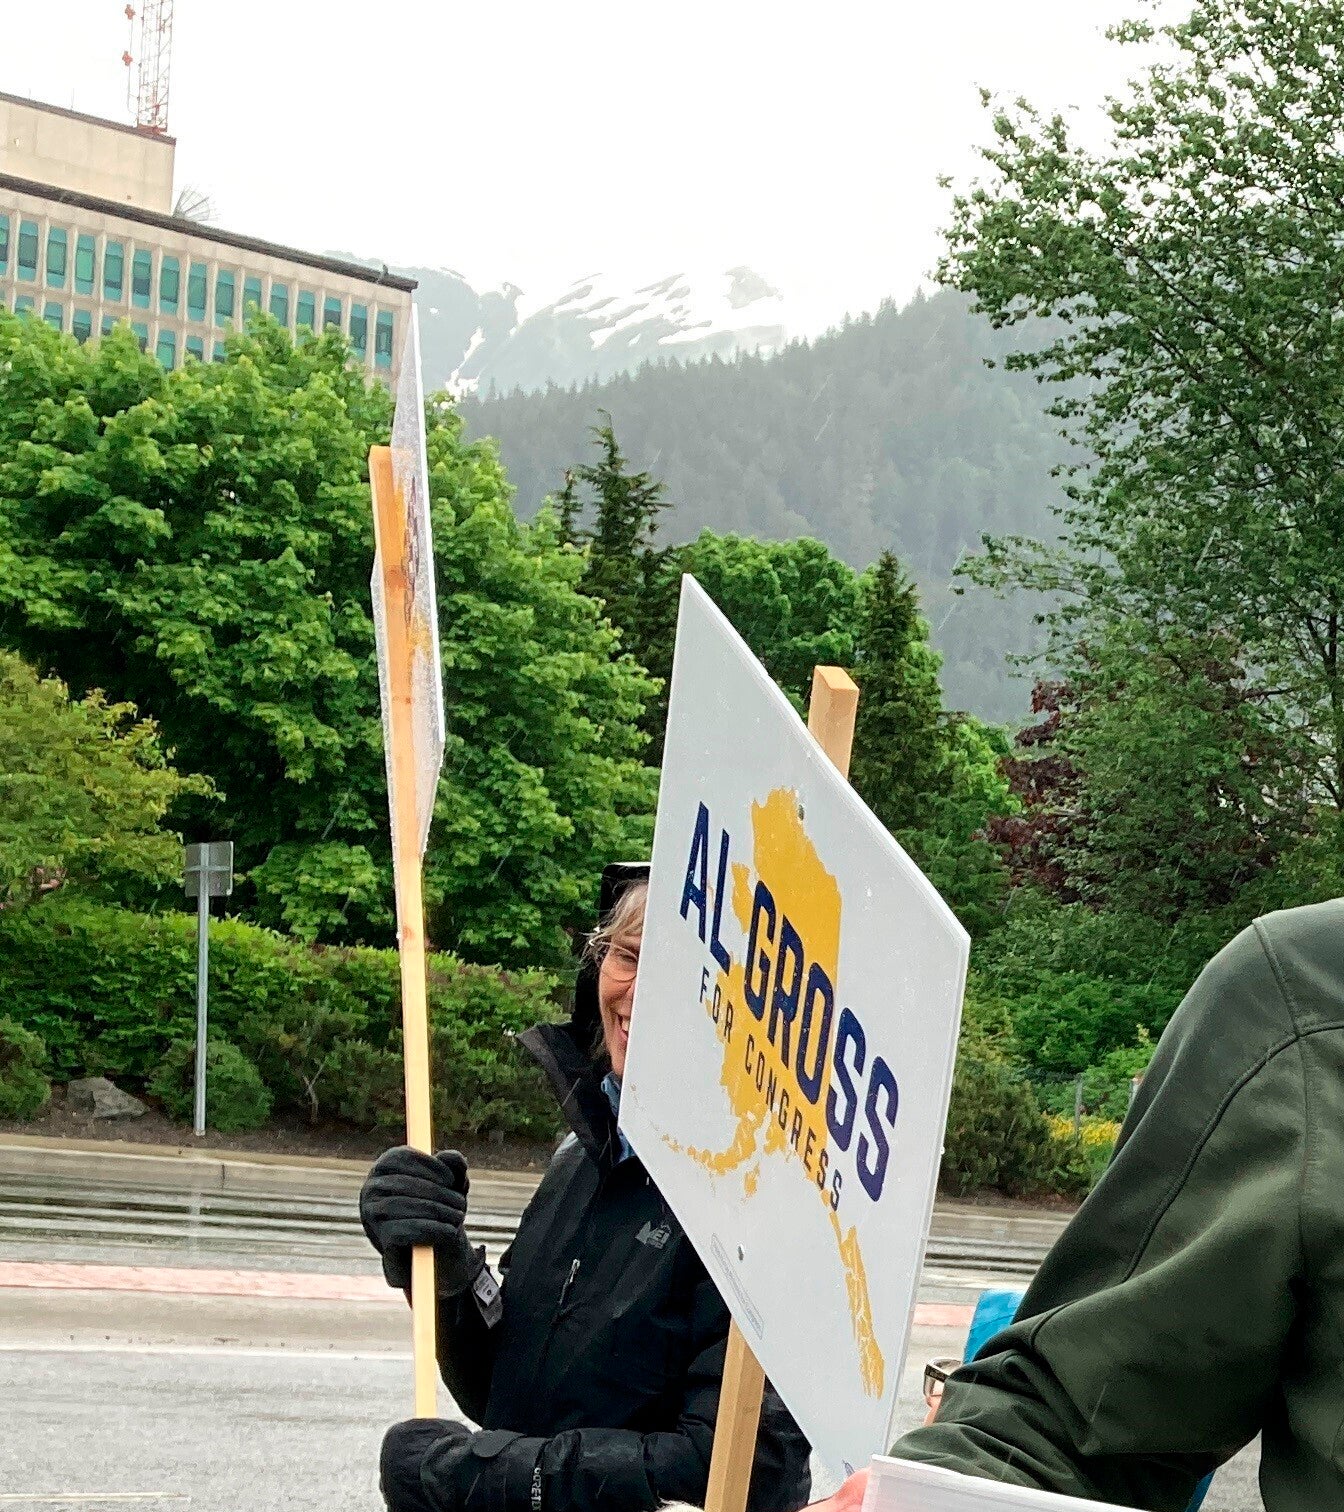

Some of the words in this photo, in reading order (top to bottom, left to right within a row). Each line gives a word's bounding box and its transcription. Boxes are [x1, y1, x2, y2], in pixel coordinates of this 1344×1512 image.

[680, 801, 731, 976] AL
[744, 880, 899, 1203] GROSS
[699, 966, 734, 1044] FOR
[744, 1031, 842, 1213] CONGRESS
